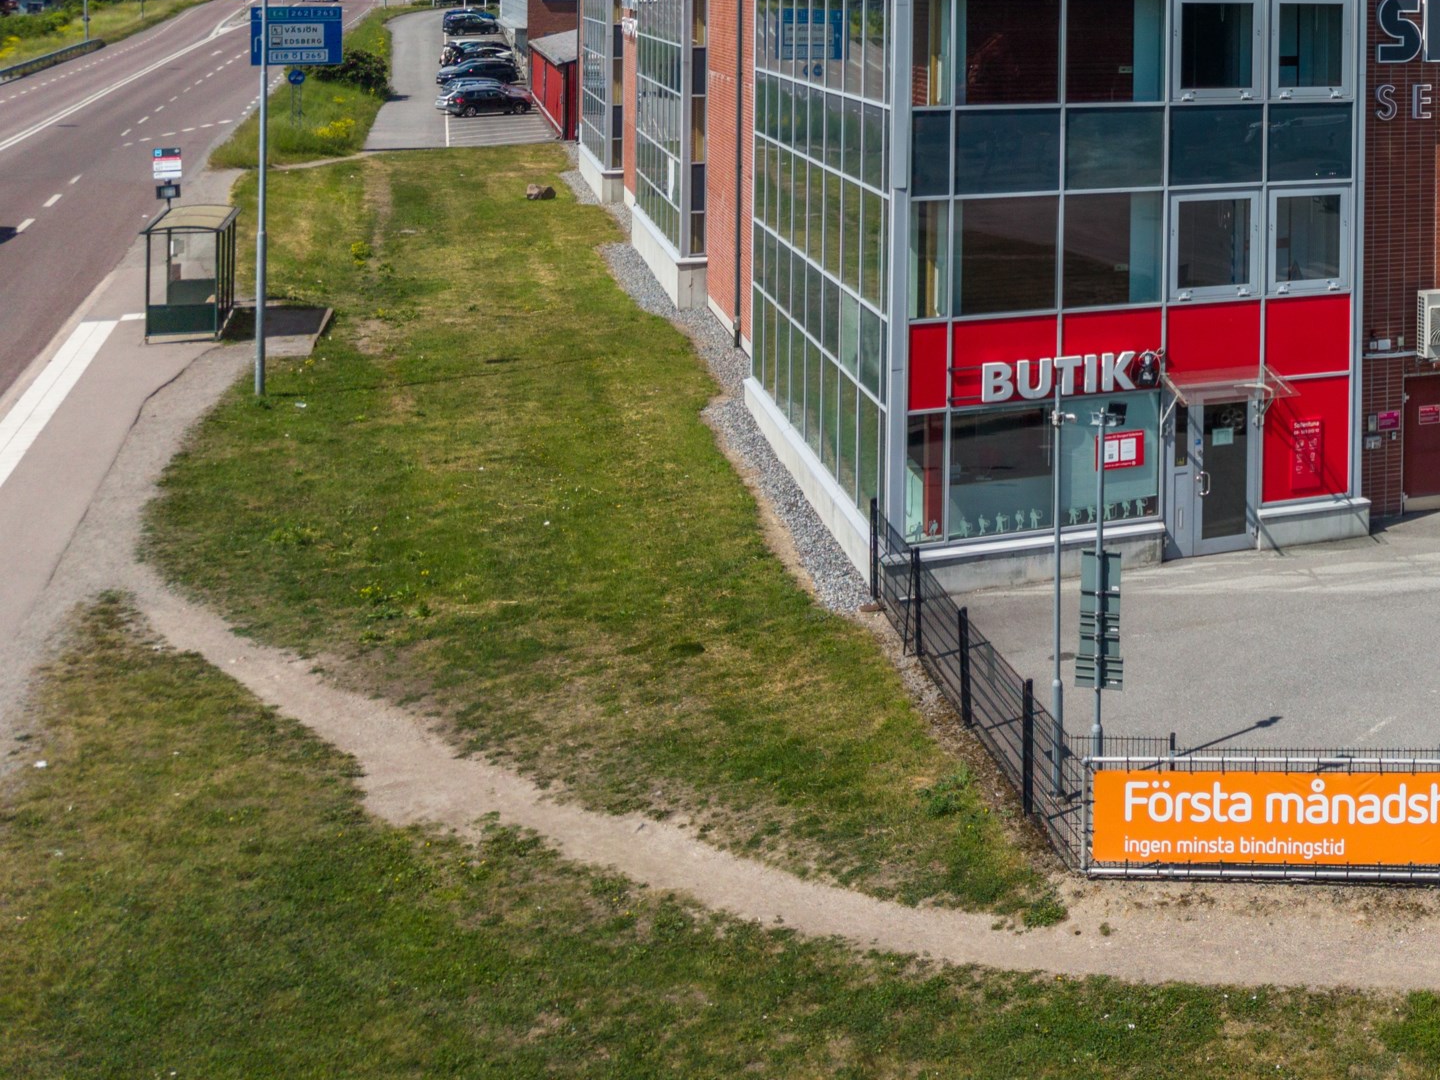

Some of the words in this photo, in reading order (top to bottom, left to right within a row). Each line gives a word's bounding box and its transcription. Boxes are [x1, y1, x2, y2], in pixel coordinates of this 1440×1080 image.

[273, 9, 284, 17] E4
[291, 9, 309, 17] 262
[284, 25, 318, 33] VÄSJÖN
[980, 350, 1136, 403] BUTIK
[1124, 780, 1253, 824] Första
[1124, 836, 1171, 858] ingen
[1176, 836, 1234, 854] minsta
[1239, 837, 1345, 859] bindningstid
